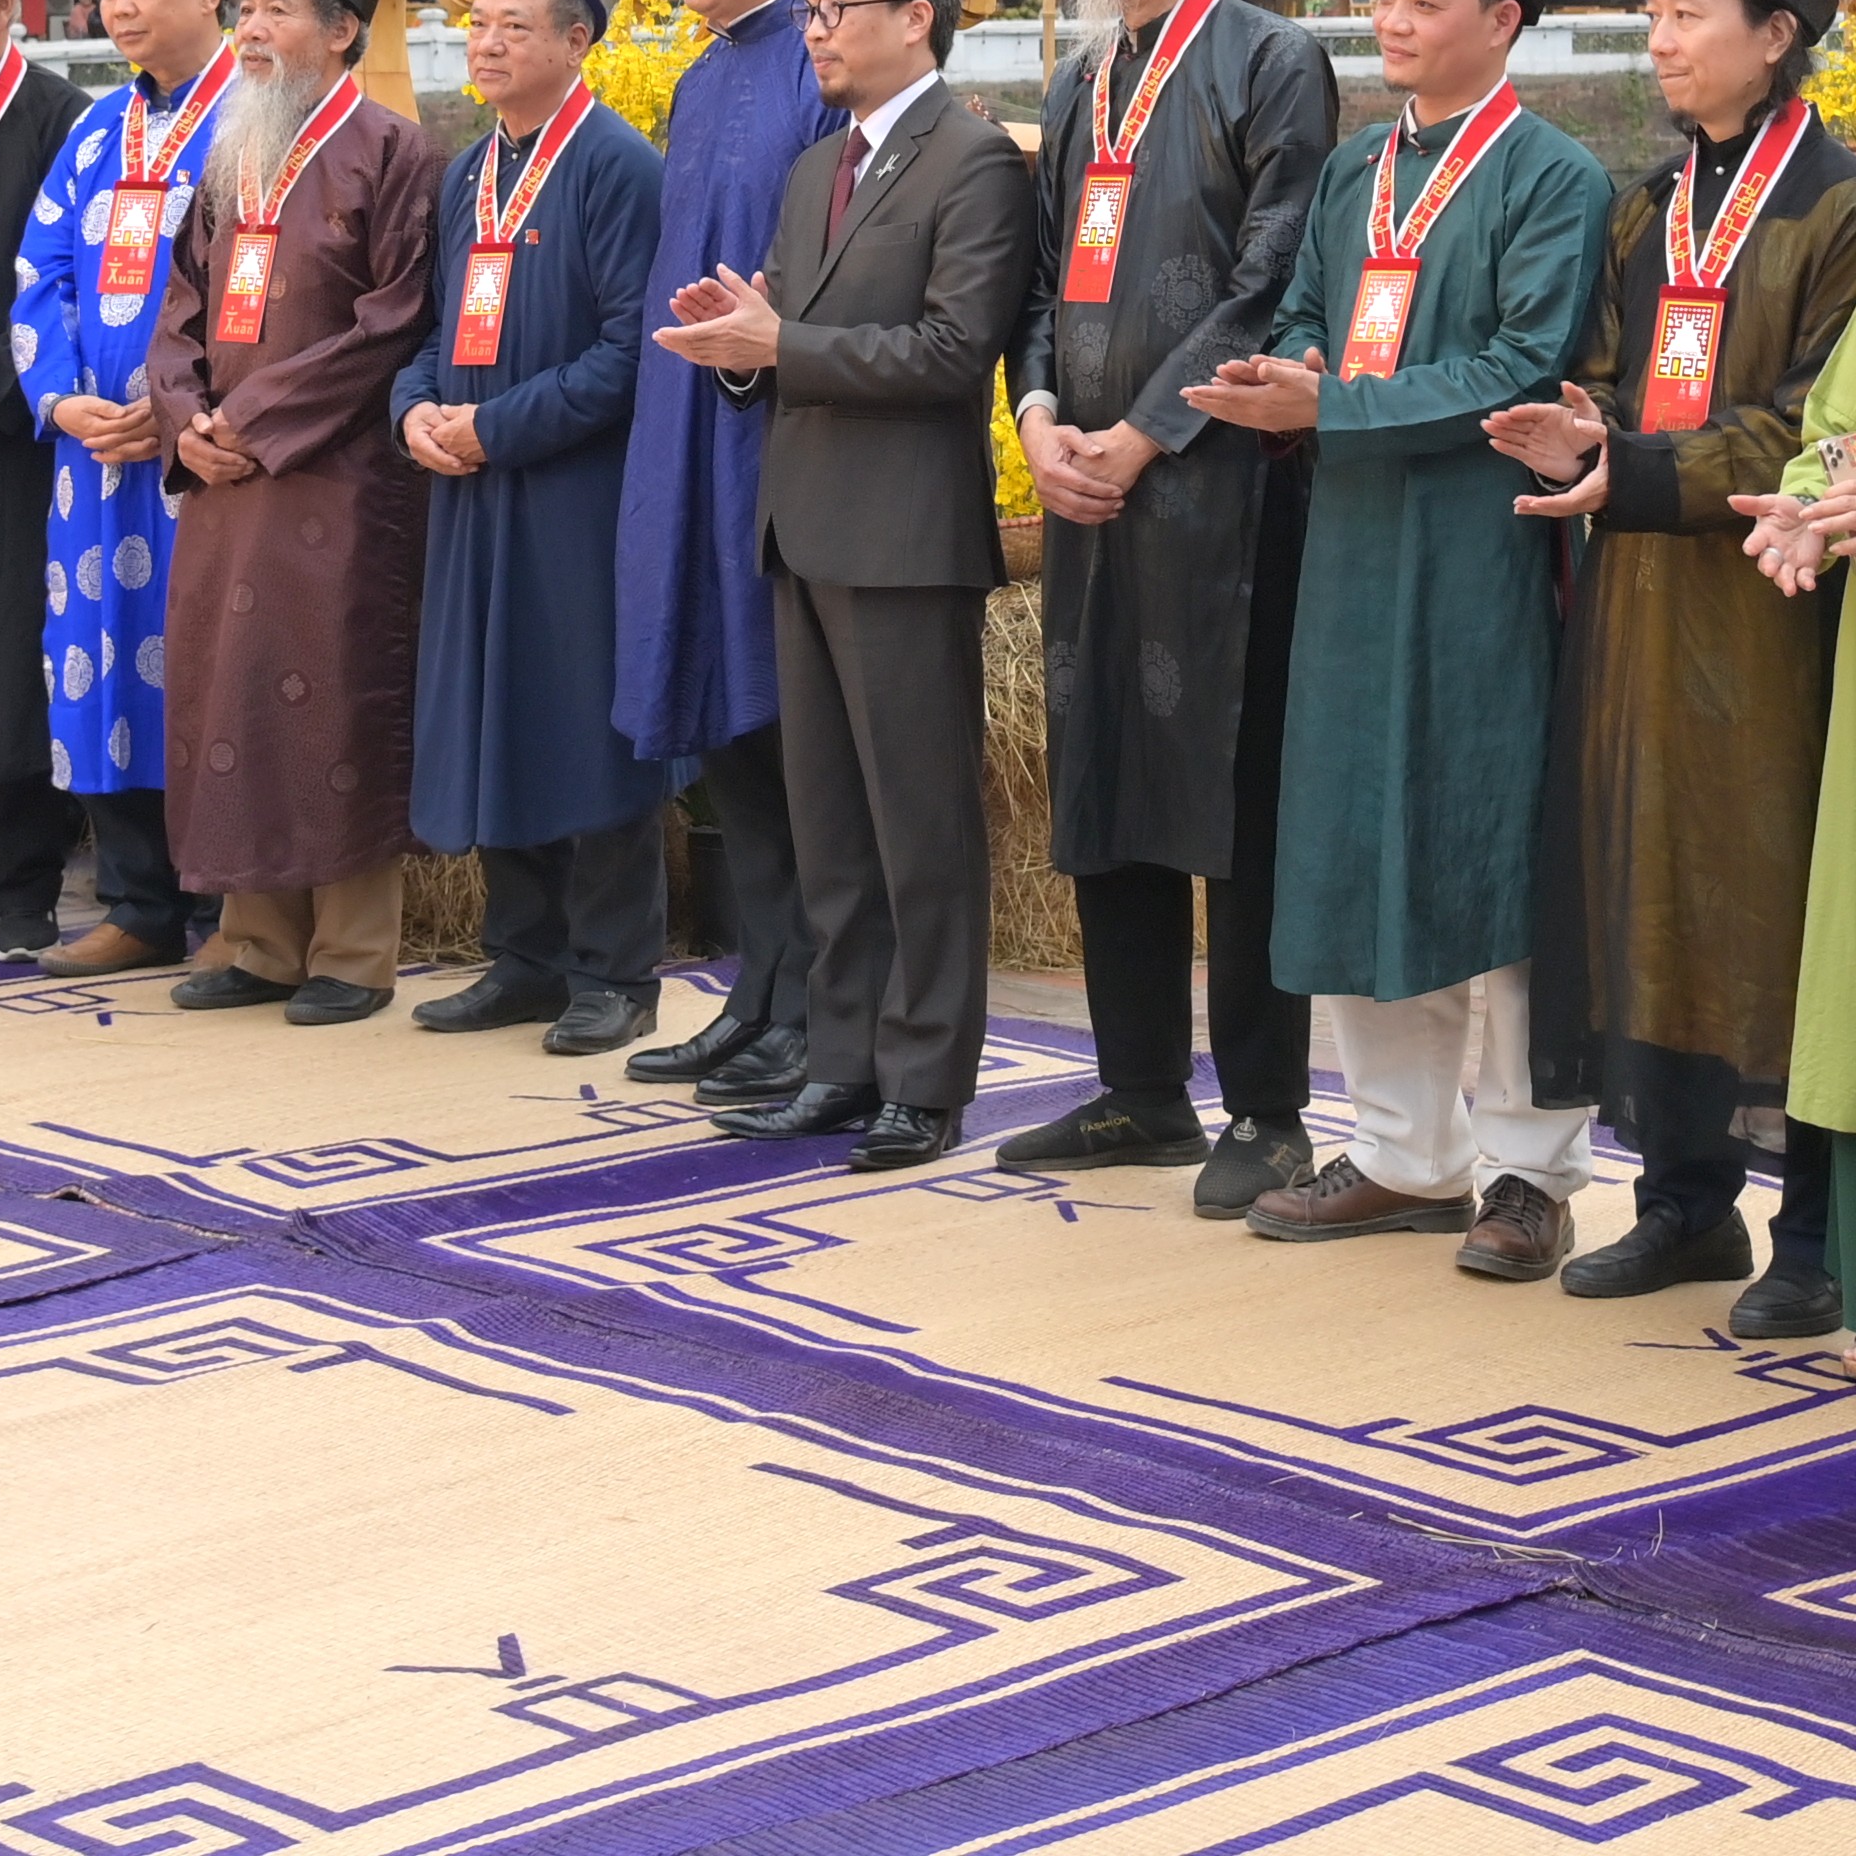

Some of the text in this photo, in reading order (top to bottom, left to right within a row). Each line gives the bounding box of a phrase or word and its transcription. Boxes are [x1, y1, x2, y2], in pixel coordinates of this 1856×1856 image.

[112, 229, 153, 245] 2026
[1080, 227, 1116, 245] 2026
[230, 276, 263, 293] 2026
[466, 297, 499, 313] 2026
[1355, 321, 1398, 340] 2026
[1657, 356, 1707, 378] 2026
[1079, 1115, 1132, 1133] FASHION
